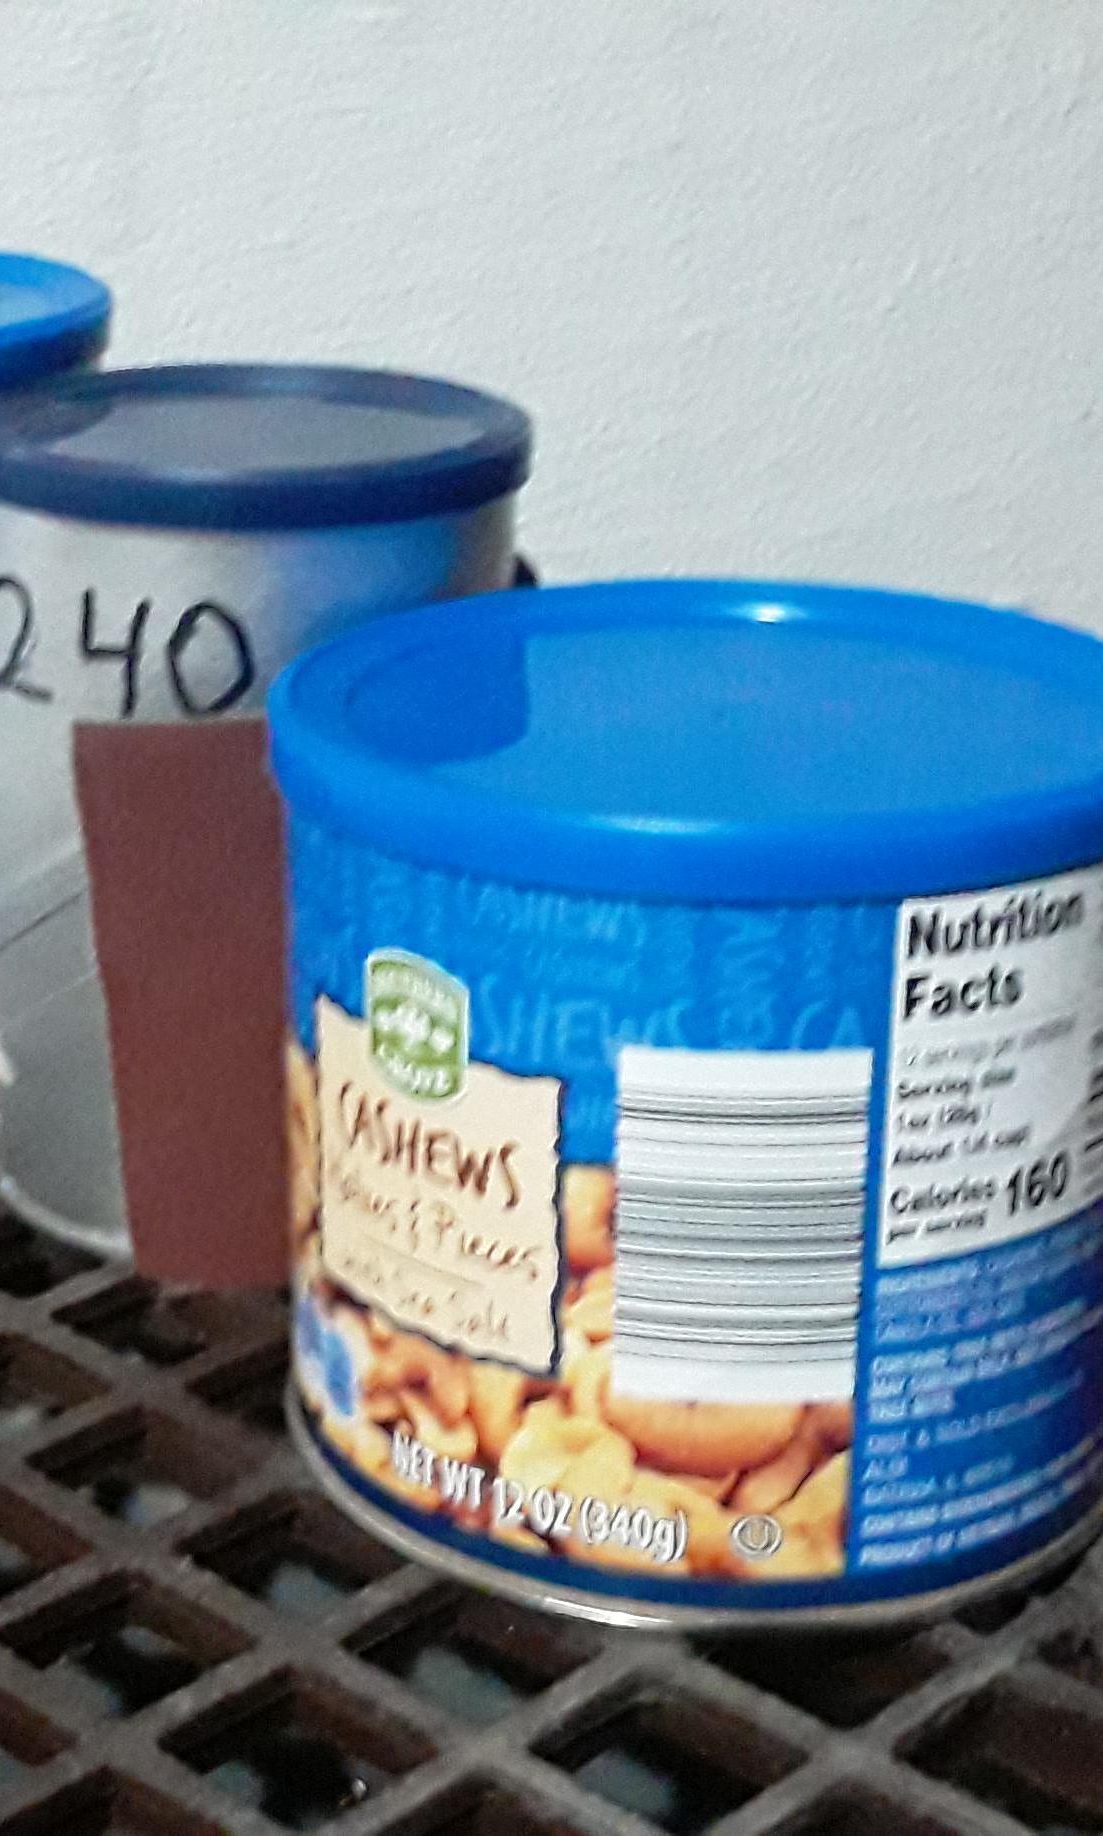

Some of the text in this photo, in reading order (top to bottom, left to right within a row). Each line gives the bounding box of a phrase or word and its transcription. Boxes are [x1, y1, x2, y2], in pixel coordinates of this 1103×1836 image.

[907, 890, 1086, 958] Nutrition
[902, 966, 1025, 1021] Facts
[337, 1080, 520, 1211] CASHEWS
[890, 1150, 1069, 1217] Calories 160
[391, 1429, 689, 1565] NET WT 12 OZ (340g)
